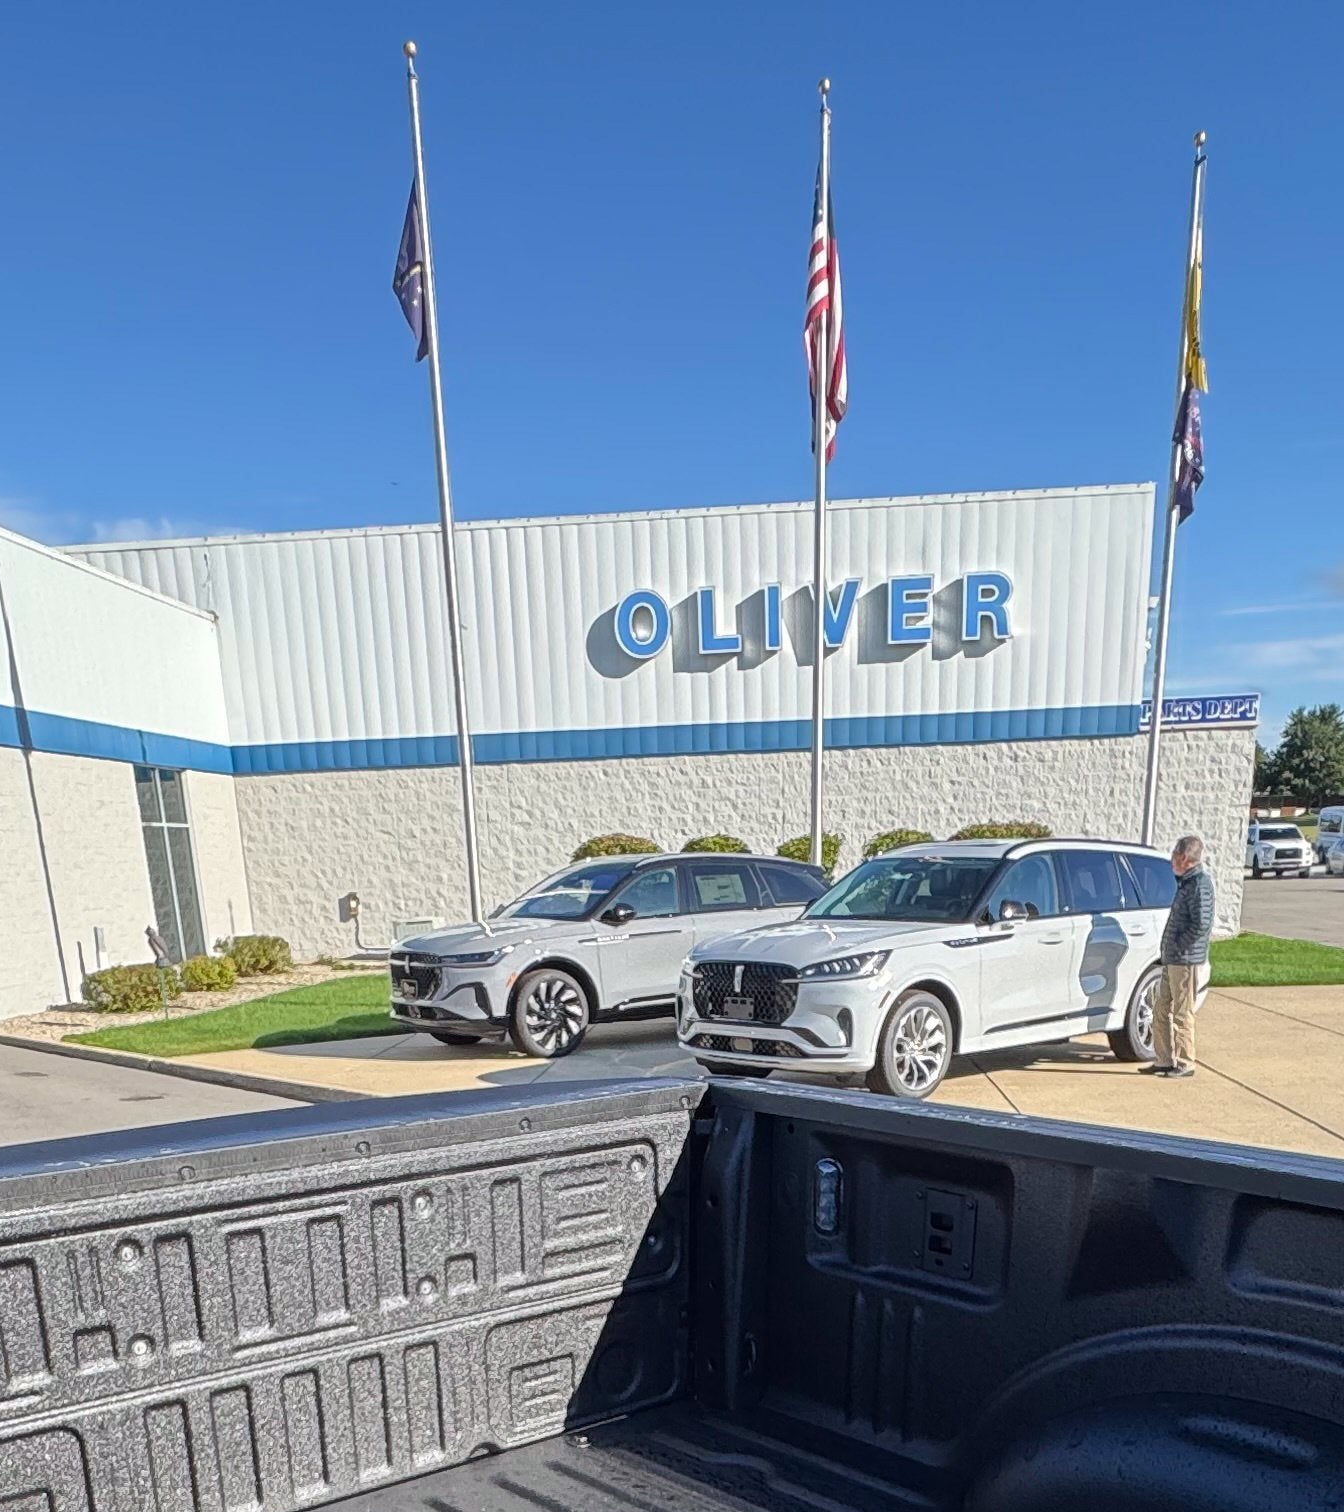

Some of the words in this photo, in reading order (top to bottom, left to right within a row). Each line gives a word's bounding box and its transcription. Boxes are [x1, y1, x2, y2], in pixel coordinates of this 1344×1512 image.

[614, 570, 1014, 659] OLIVER
[1140, 701, 1202, 723] PRTS
[1206, 698, 1258, 720] DEPT
